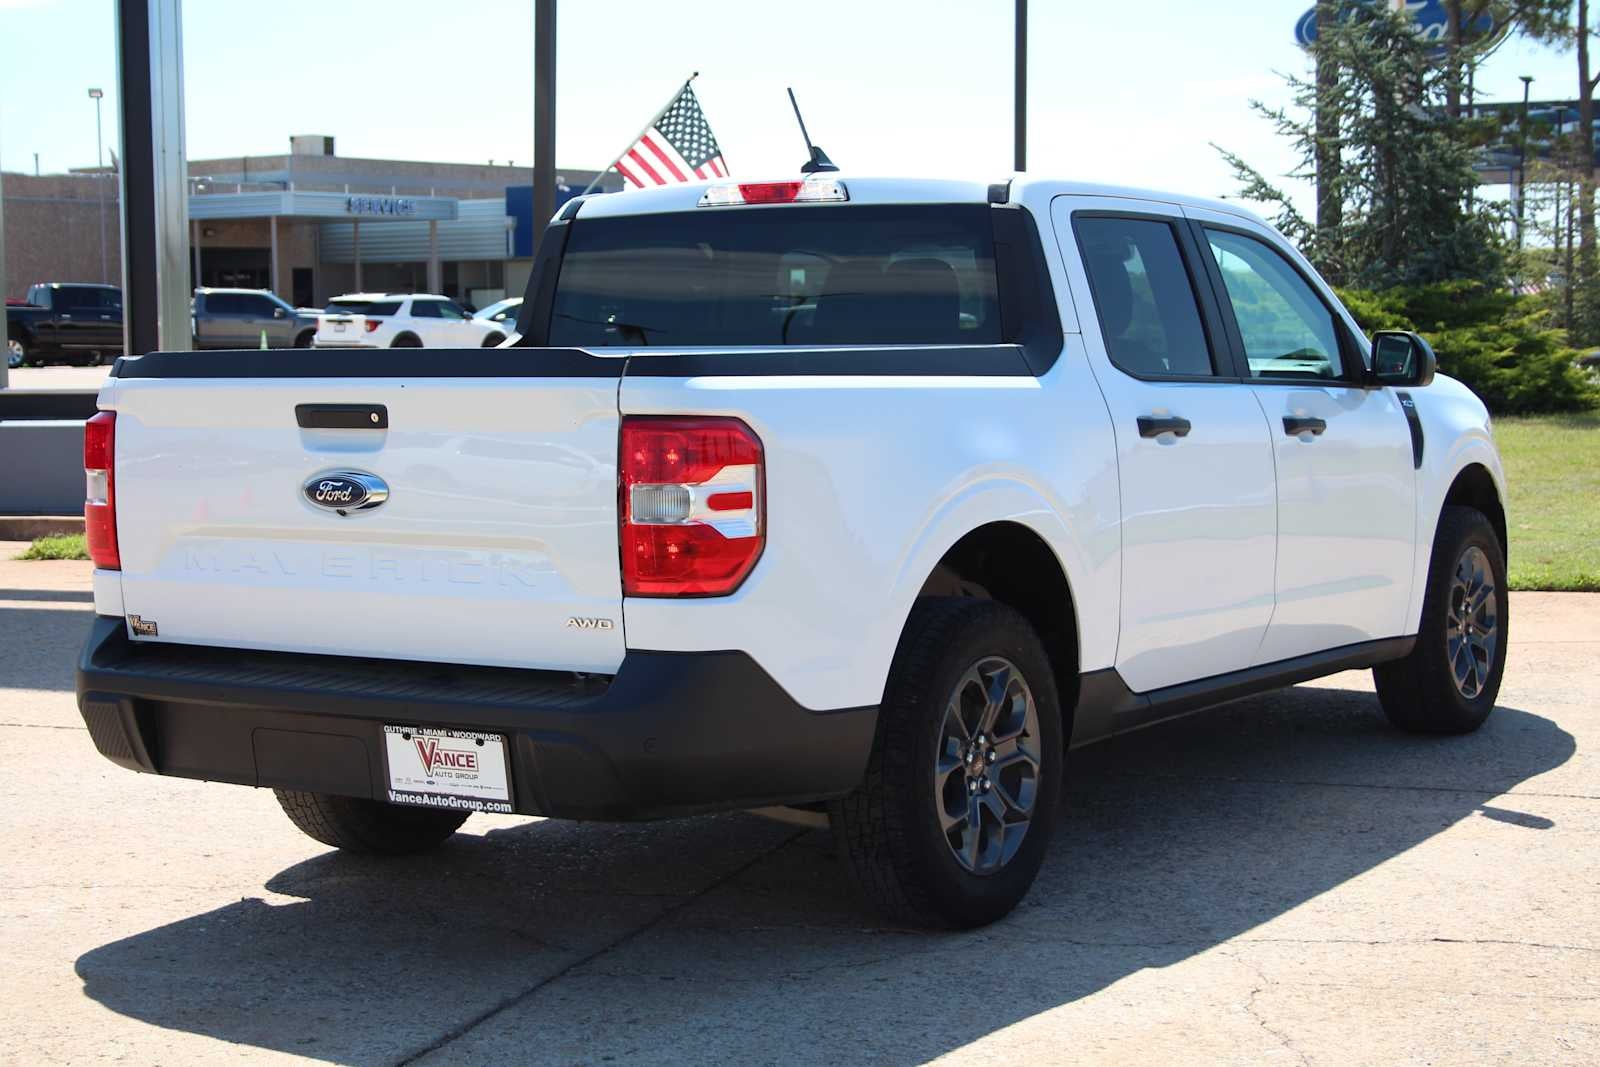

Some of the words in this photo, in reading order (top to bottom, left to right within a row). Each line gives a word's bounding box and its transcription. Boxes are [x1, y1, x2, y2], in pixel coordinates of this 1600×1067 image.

[347, 197, 416, 215] SERVICE
[315, 480, 352, 501] Ford
[183, 549, 537, 590] MAVERICK
[567, 616, 614, 630] AWD
[384, 725, 418, 736] GUTHRIE
[423, 728, 447, 737] MIAMI
[452, 731, 502, 742] WOODWARD
[413, 736, 478, 777] VANCE
[435, 771, 453, 779] AUTO
[388, 790, 512, 812] VanceAutoGroup.com
